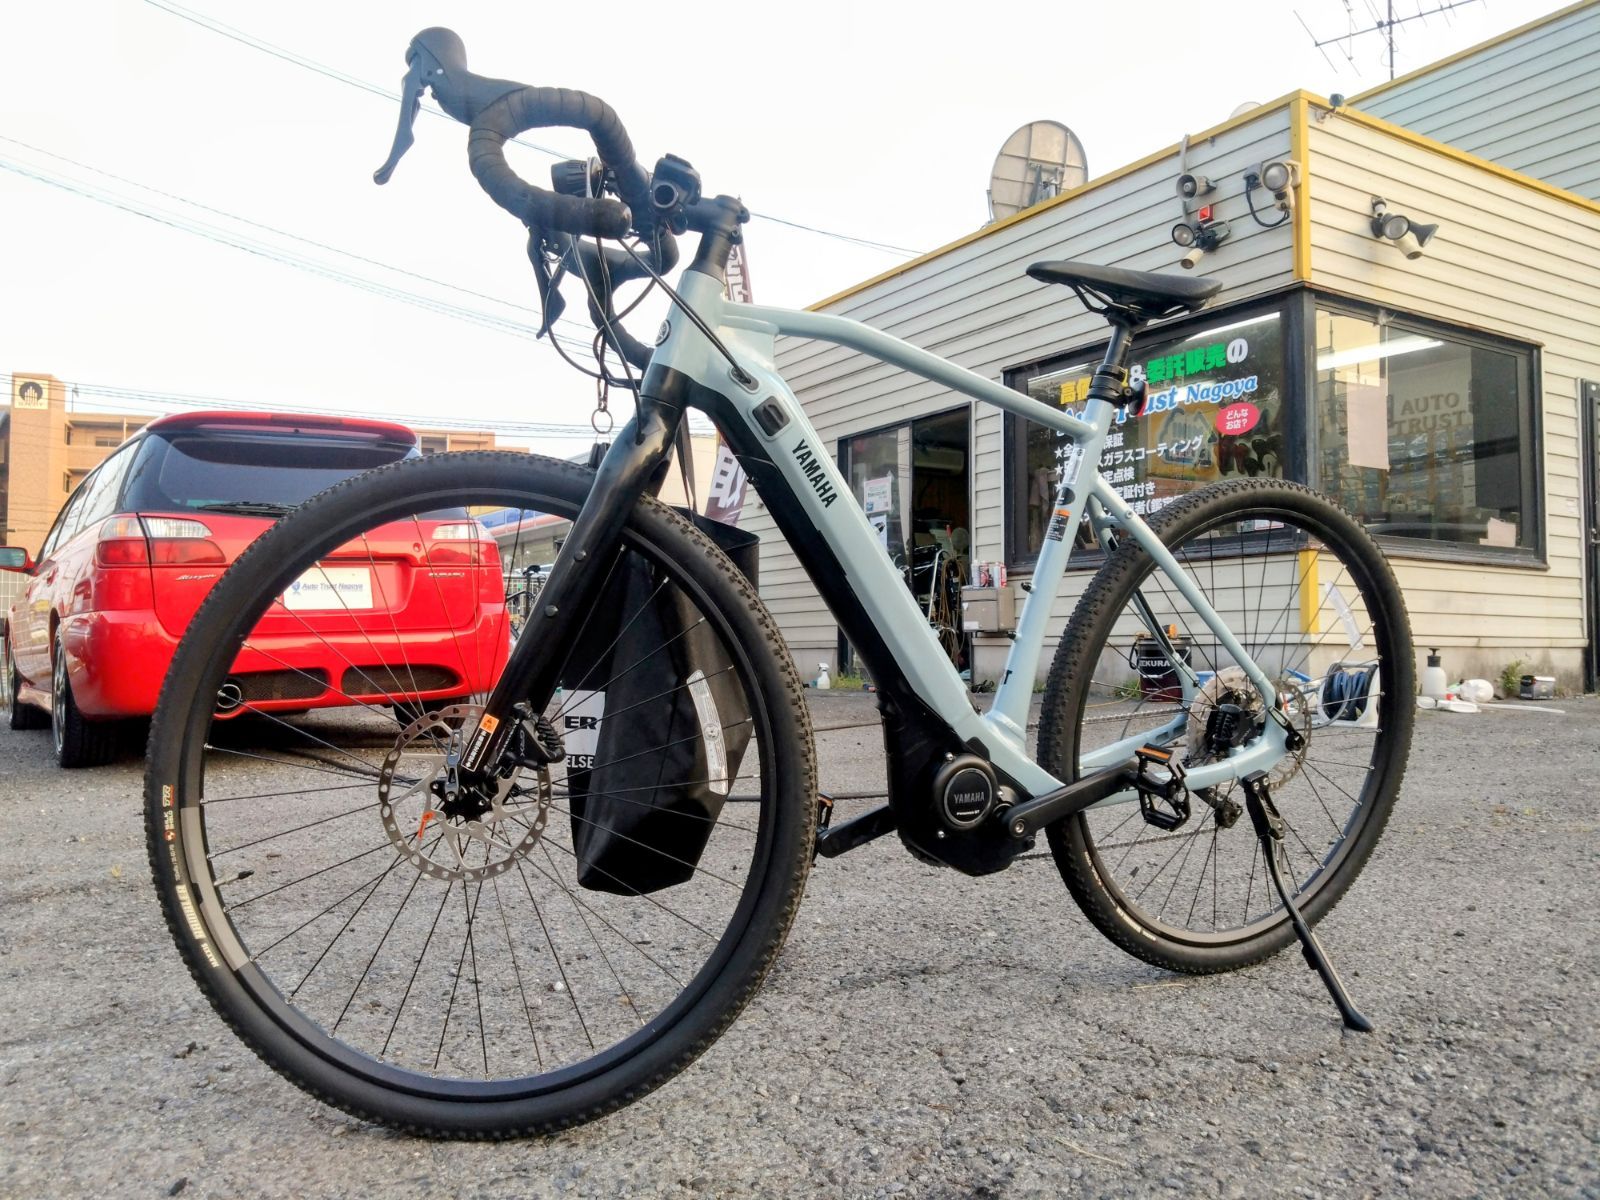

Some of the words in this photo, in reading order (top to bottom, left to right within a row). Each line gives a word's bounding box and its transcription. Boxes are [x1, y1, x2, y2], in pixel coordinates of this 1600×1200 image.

[1184, 376, 1258, 405] Nagoya
[1226, 409, 1249, 419] どんな
[1400, 392, 1460, 415] AUTO
[1394, 410, 1466, 435] TRUST
[792, 438, 838, 509] YAMAHA
[954, 791, 985, 805] YAMAHA
[201, 943, 220, 968] MAXXIS
